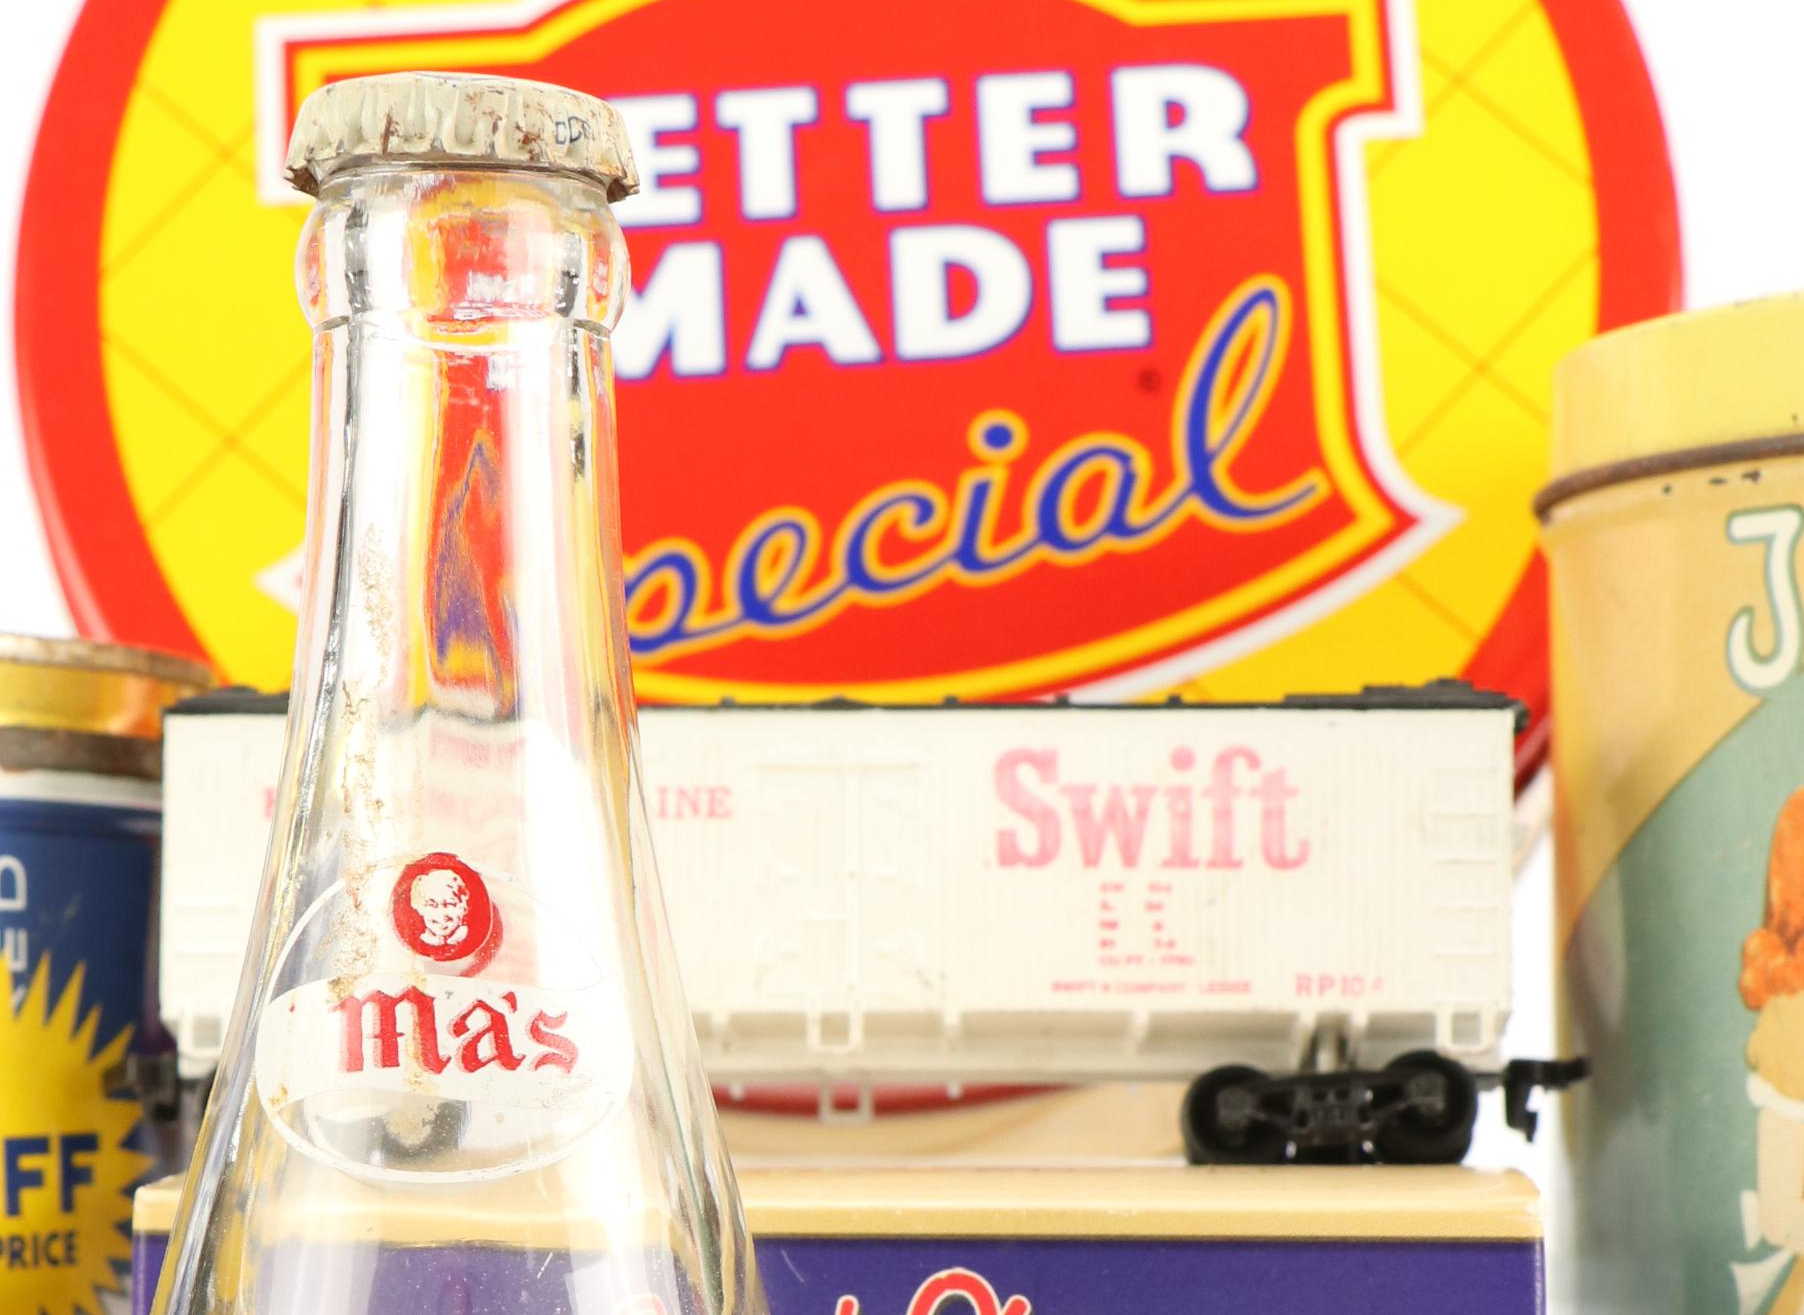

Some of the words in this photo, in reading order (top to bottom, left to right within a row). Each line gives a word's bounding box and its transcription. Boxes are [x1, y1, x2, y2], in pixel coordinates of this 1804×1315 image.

[603, 64, 1257, 227] ETTER
[656, 784, 733, 820] INE
[994, 746, 1310, 871] Swift
[331, 984, 583, 1075] Ma's
